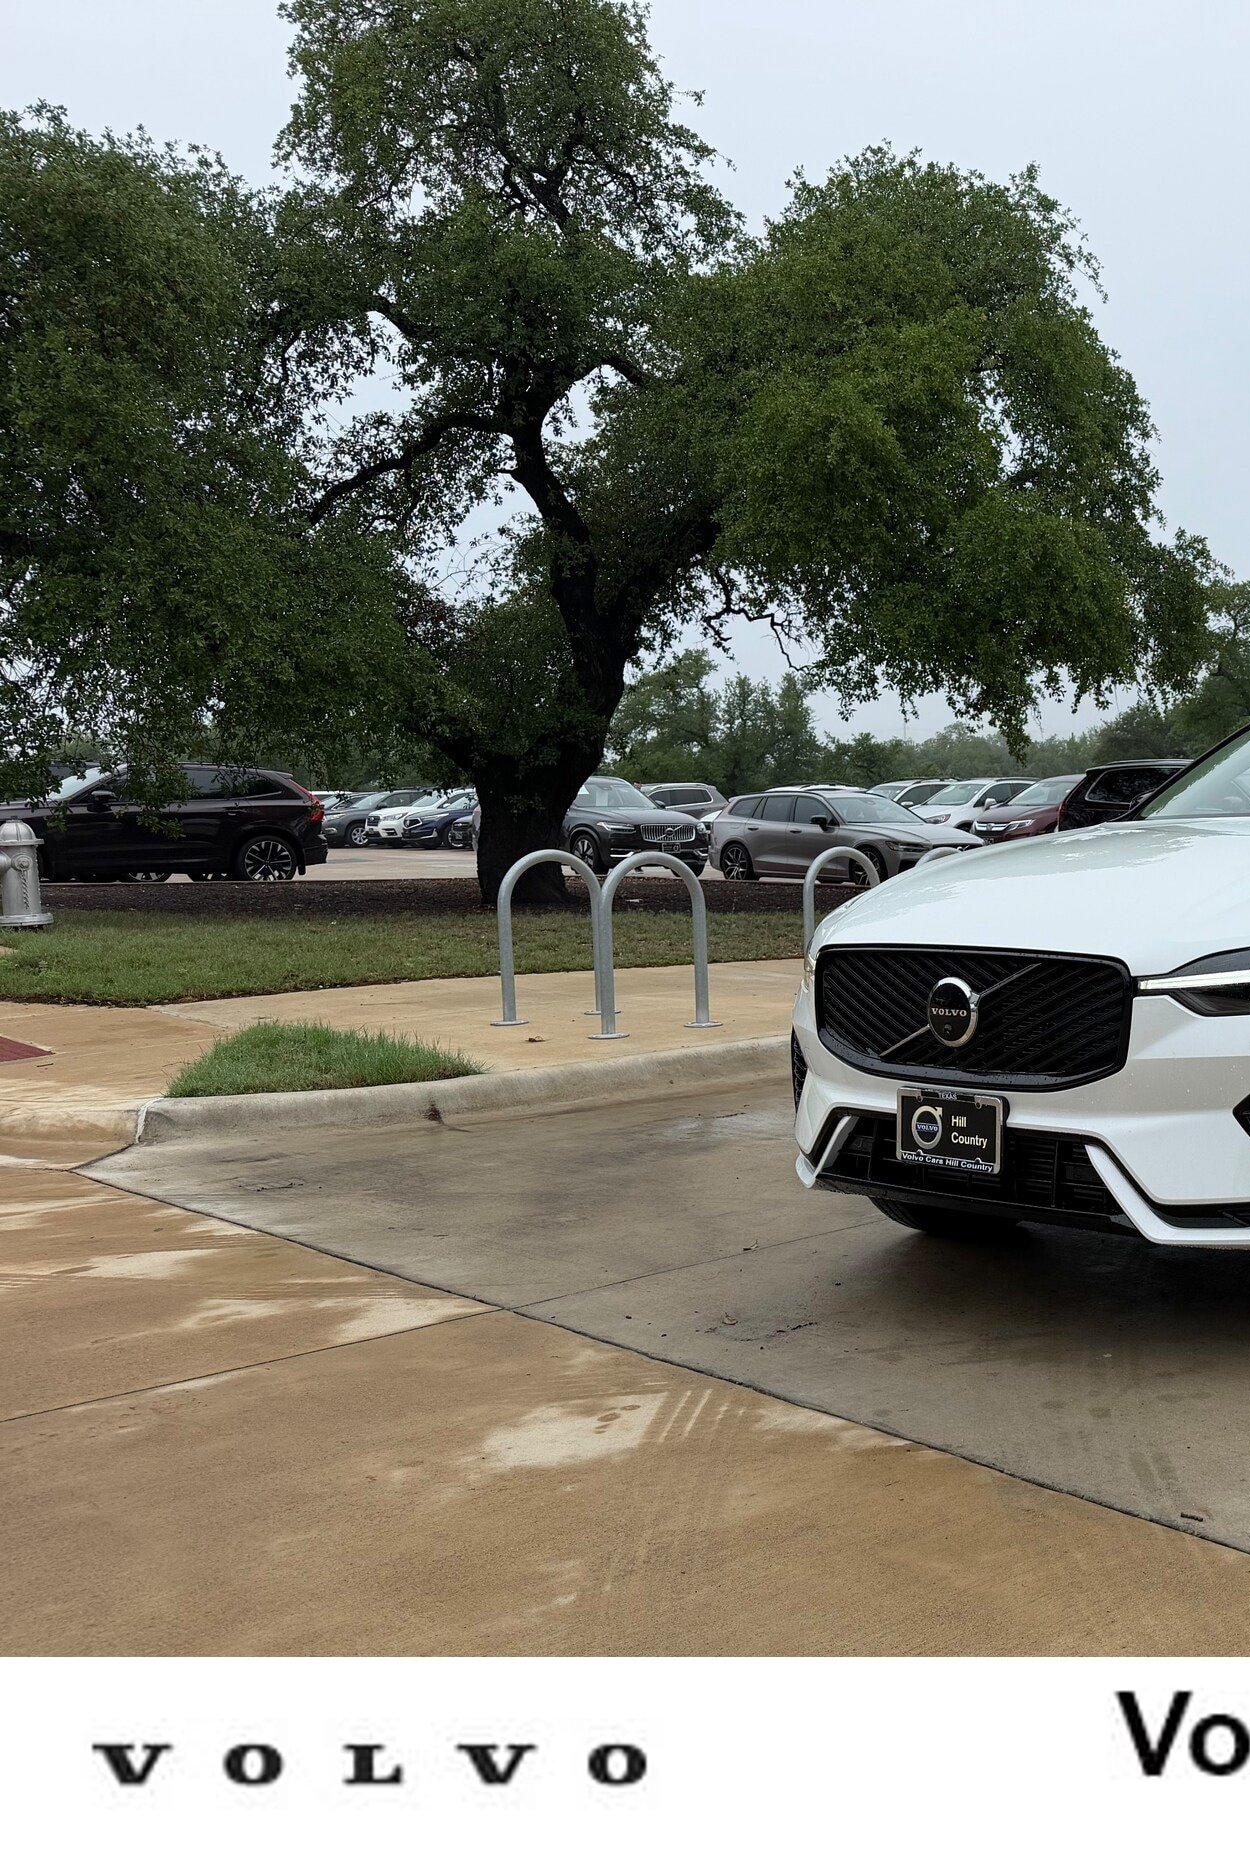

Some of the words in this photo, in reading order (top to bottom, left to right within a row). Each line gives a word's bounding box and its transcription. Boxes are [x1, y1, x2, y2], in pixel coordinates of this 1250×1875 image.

[931, 1007, 967, 1017] VOLVO
[938, 1092, 958, 1100] TEXAS
[951, 1115, 967, 1128] Hill
[916, 1124, 939, 1132] VOLVO
[951, 1132, 988, 1148] Country
[902, 1153, 924, 1162] Volvo
[925, 1156, 944, 1165] Cars
[945, 1159, 959, 1167] Hill
[960, 1161, 993, 1173] Country
